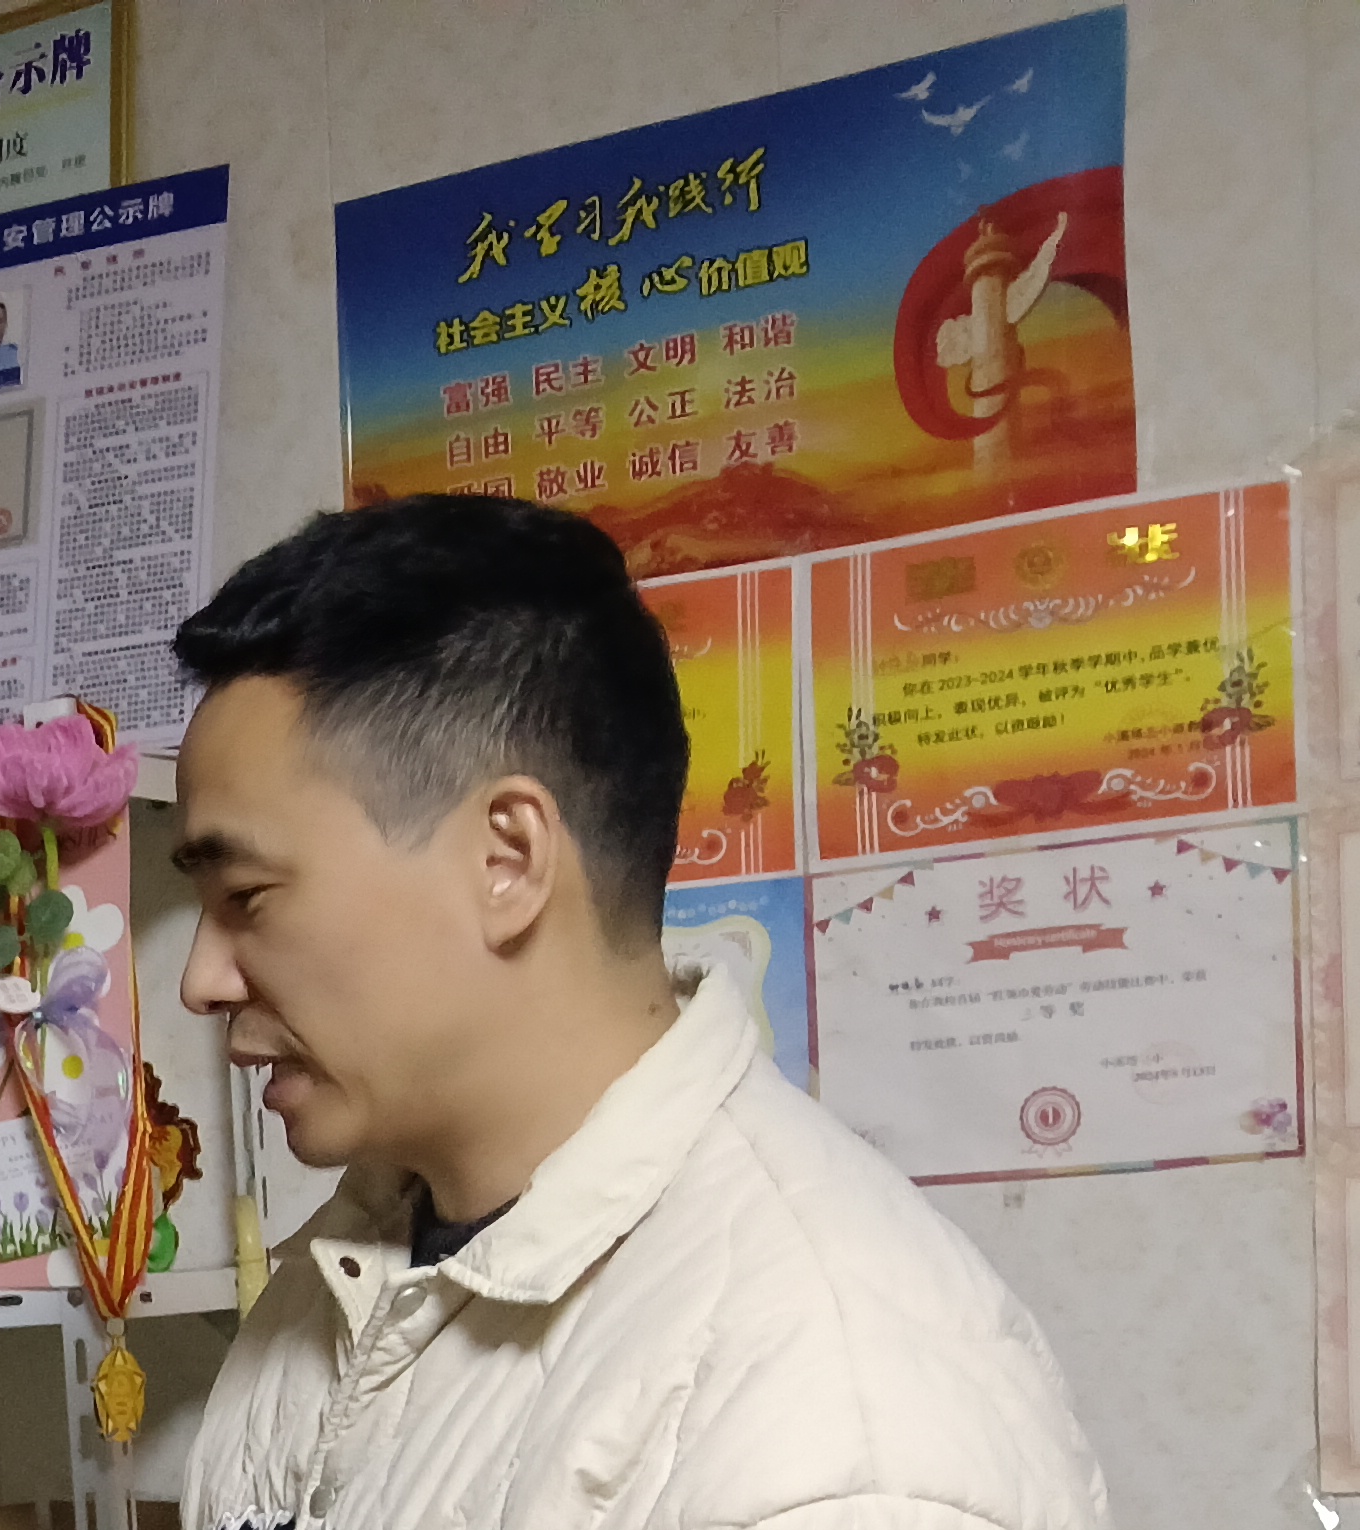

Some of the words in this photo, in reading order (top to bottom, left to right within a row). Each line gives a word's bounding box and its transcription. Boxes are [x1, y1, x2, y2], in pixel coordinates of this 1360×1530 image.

[458, 147, 766, 284] 我学习我践行
[435, 239, 809, 355] 社会主义核心价值观
[442, 374, 511, 417] 富强
[532, 355, 604, 397] 民主
[626, 331, 698, 378] 文明
[720, 311, 798, 356] 和谐
[446, 425, 513, 470] 自由
[535, 405, 605, 447] 平等
[627, 387, 699, 430] 公正
[721, 365, 798, 412] 法治
[534, 459, 609, 502] 敬业
[628, 438, 701, 482] 诚信
[726, 419, 801, 464] 友善
[977, 863, 1112, 924] 奖状
